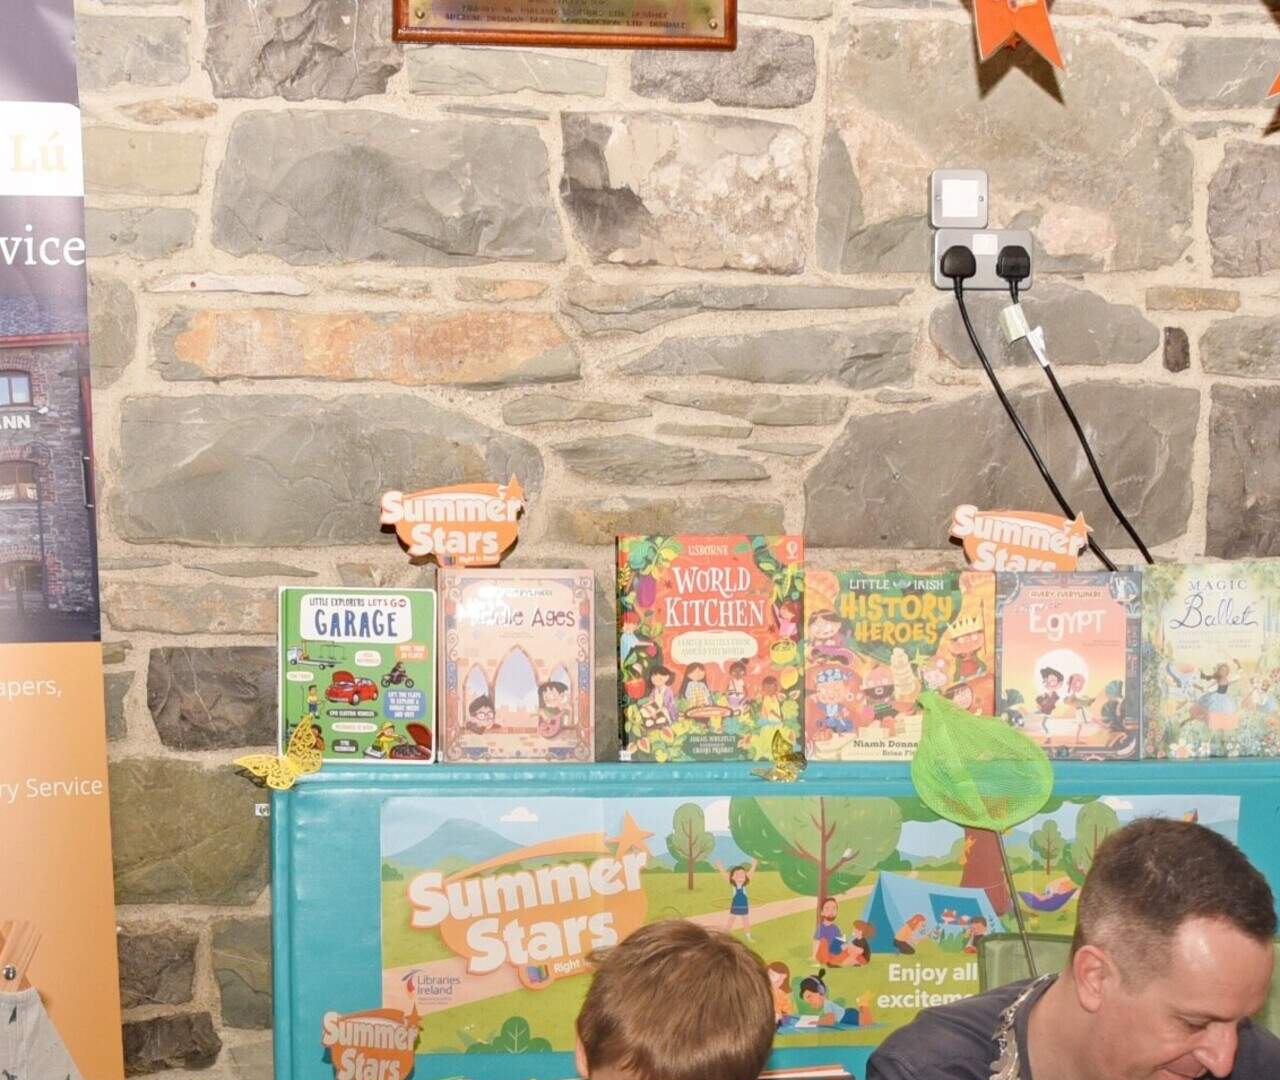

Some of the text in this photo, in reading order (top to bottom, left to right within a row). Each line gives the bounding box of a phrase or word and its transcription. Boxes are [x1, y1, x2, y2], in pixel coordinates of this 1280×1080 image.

[11, 128, 67, 174] Lú
[380, 489, 523, 524] Summer
[410, 522, 500, 556] Stars
[952, 504, 1088, 558] Summer
[688, 544, 729, 556] USBORNE
[975, 542, 1058, 571] Stars
[672, 566, 751, 599] WORLD
[849, 578, 945, 590] LITTLE IRISH
[1189, 579, 1248, 593] MAGIC
[309, 597, 328, 607] LITTLE
[331, 597, 365, 607] EXPLORERS
[664, 597, 766, 627] KITCHEN
[839, 592, 954, 624] HISTORY
[1170, 592, 1259, 629] Ballet
[314, 609, 398, 638] GARAGE
[531, 608, 576, 627] Ages
[853, 620, 939, 646] HEROES
[853, 739, 886, 749] Niamh
[26, 775, 104, 799] Service
[409, 850, 648, 929] Summer
[466, 911, 619, 974] Stars
[417, 974, 461, 986] Libraries
[888, 962, 978, 987] Enjoy all
[417, 984, 453, 996] Ireland
[323, 1011, 418, 1049] Summer
